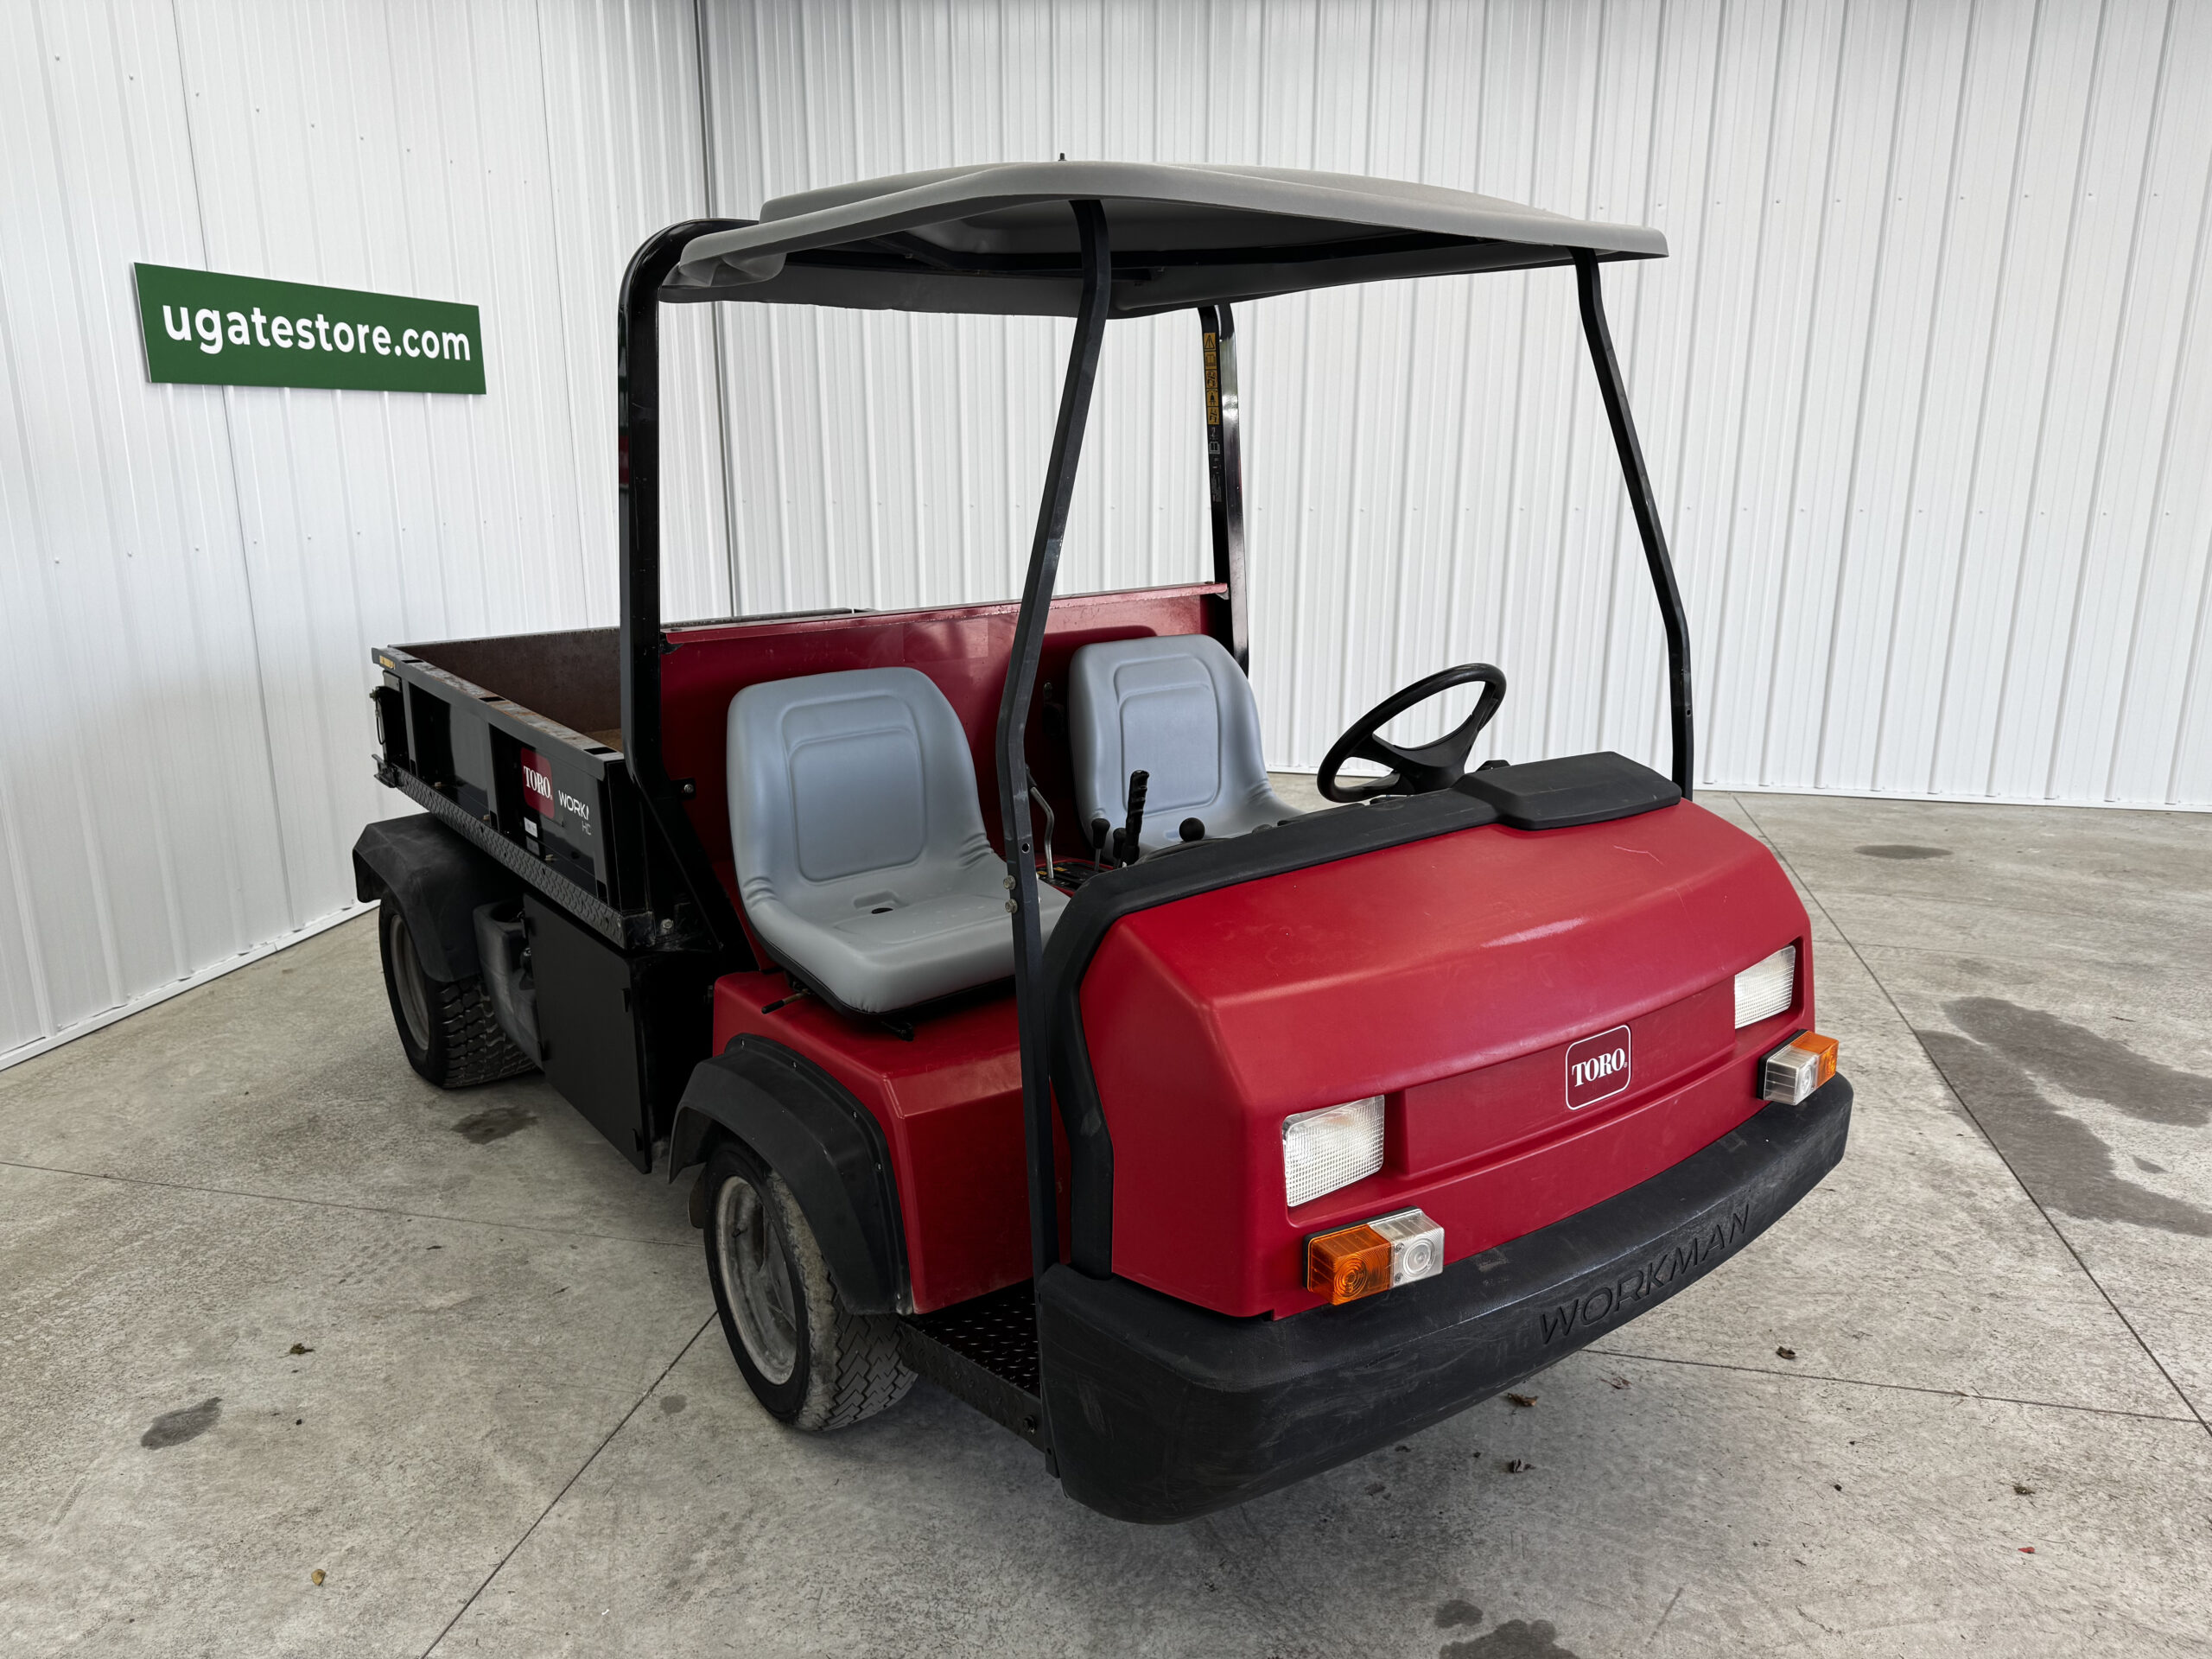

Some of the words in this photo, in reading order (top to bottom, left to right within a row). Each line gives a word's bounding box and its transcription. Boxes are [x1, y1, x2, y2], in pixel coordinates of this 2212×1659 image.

[162, 304, 471, 361] ugatestore.com
[524, 766, 551, 799] TORO
[1572, 1048, 1625, 1087] TORO
[1540, 1204, 1749, 1344] WORKMAN
